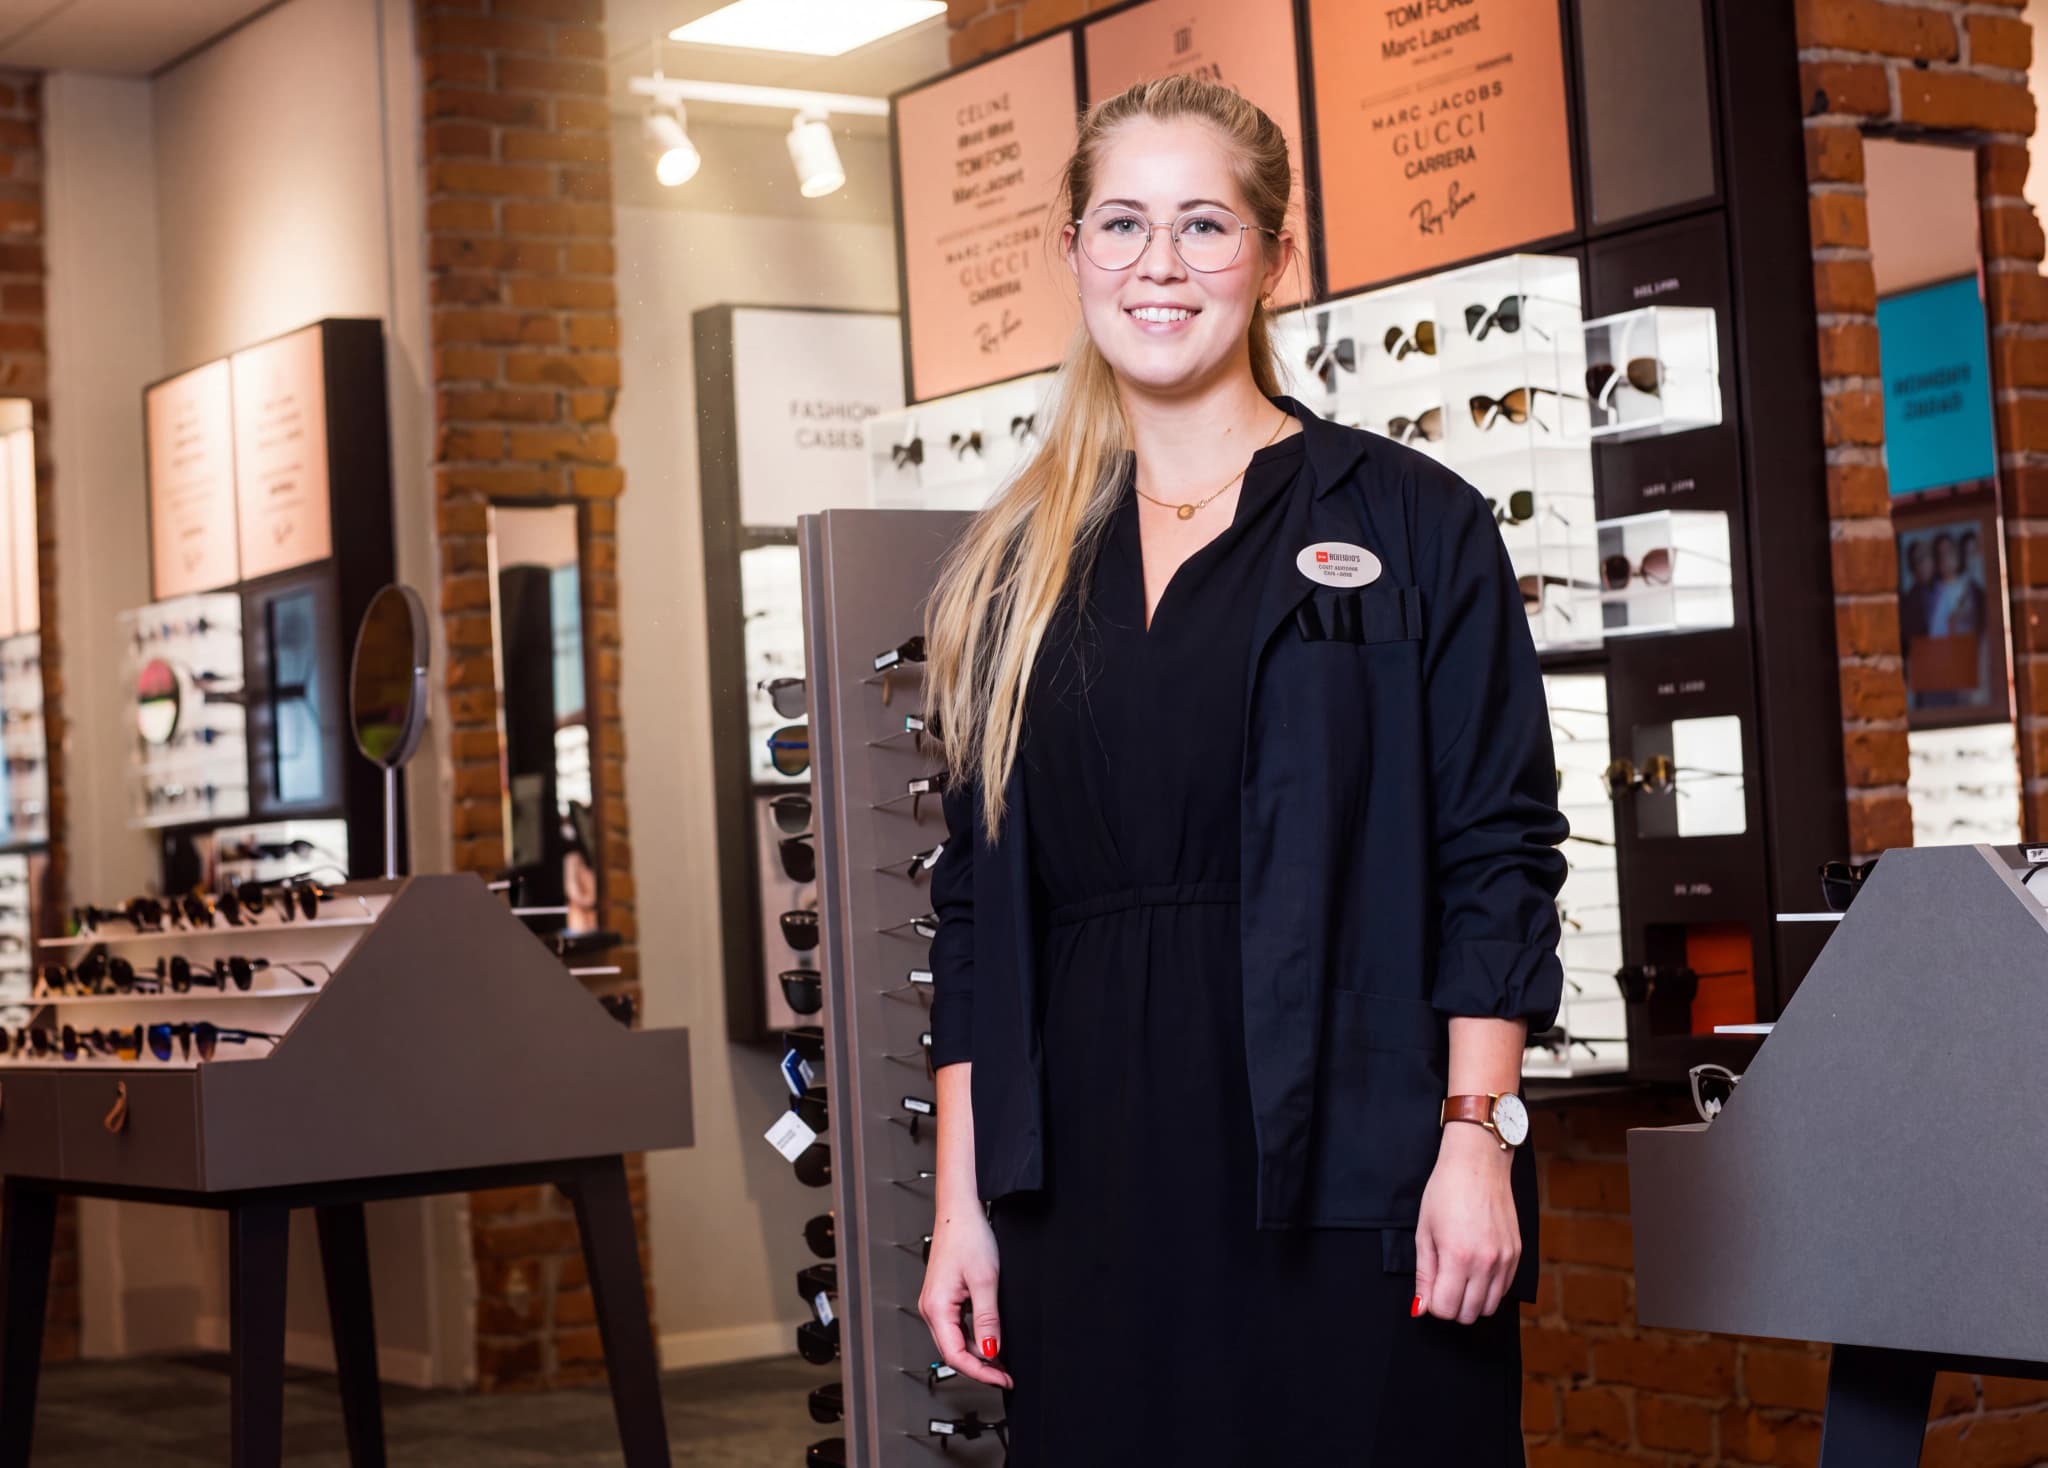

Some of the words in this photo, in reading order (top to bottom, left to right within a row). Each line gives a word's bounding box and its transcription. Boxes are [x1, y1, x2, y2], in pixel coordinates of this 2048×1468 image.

[1384, 1, 1423, 30] TOM
[1381, 35, 1418, 61] Marc
[1420, 12, 1481, 48] Laurent
[1371, 105, 1421, 131] MARC
[1428, 80, 1503, 116] JACOBS
[1392, 110, 1486, 157] GUCCI
[1404, 144, 1477, 179] CARRERA
[960, 249, 1030, 288] GUCCI
[795, 428, 864, 450] CASES
